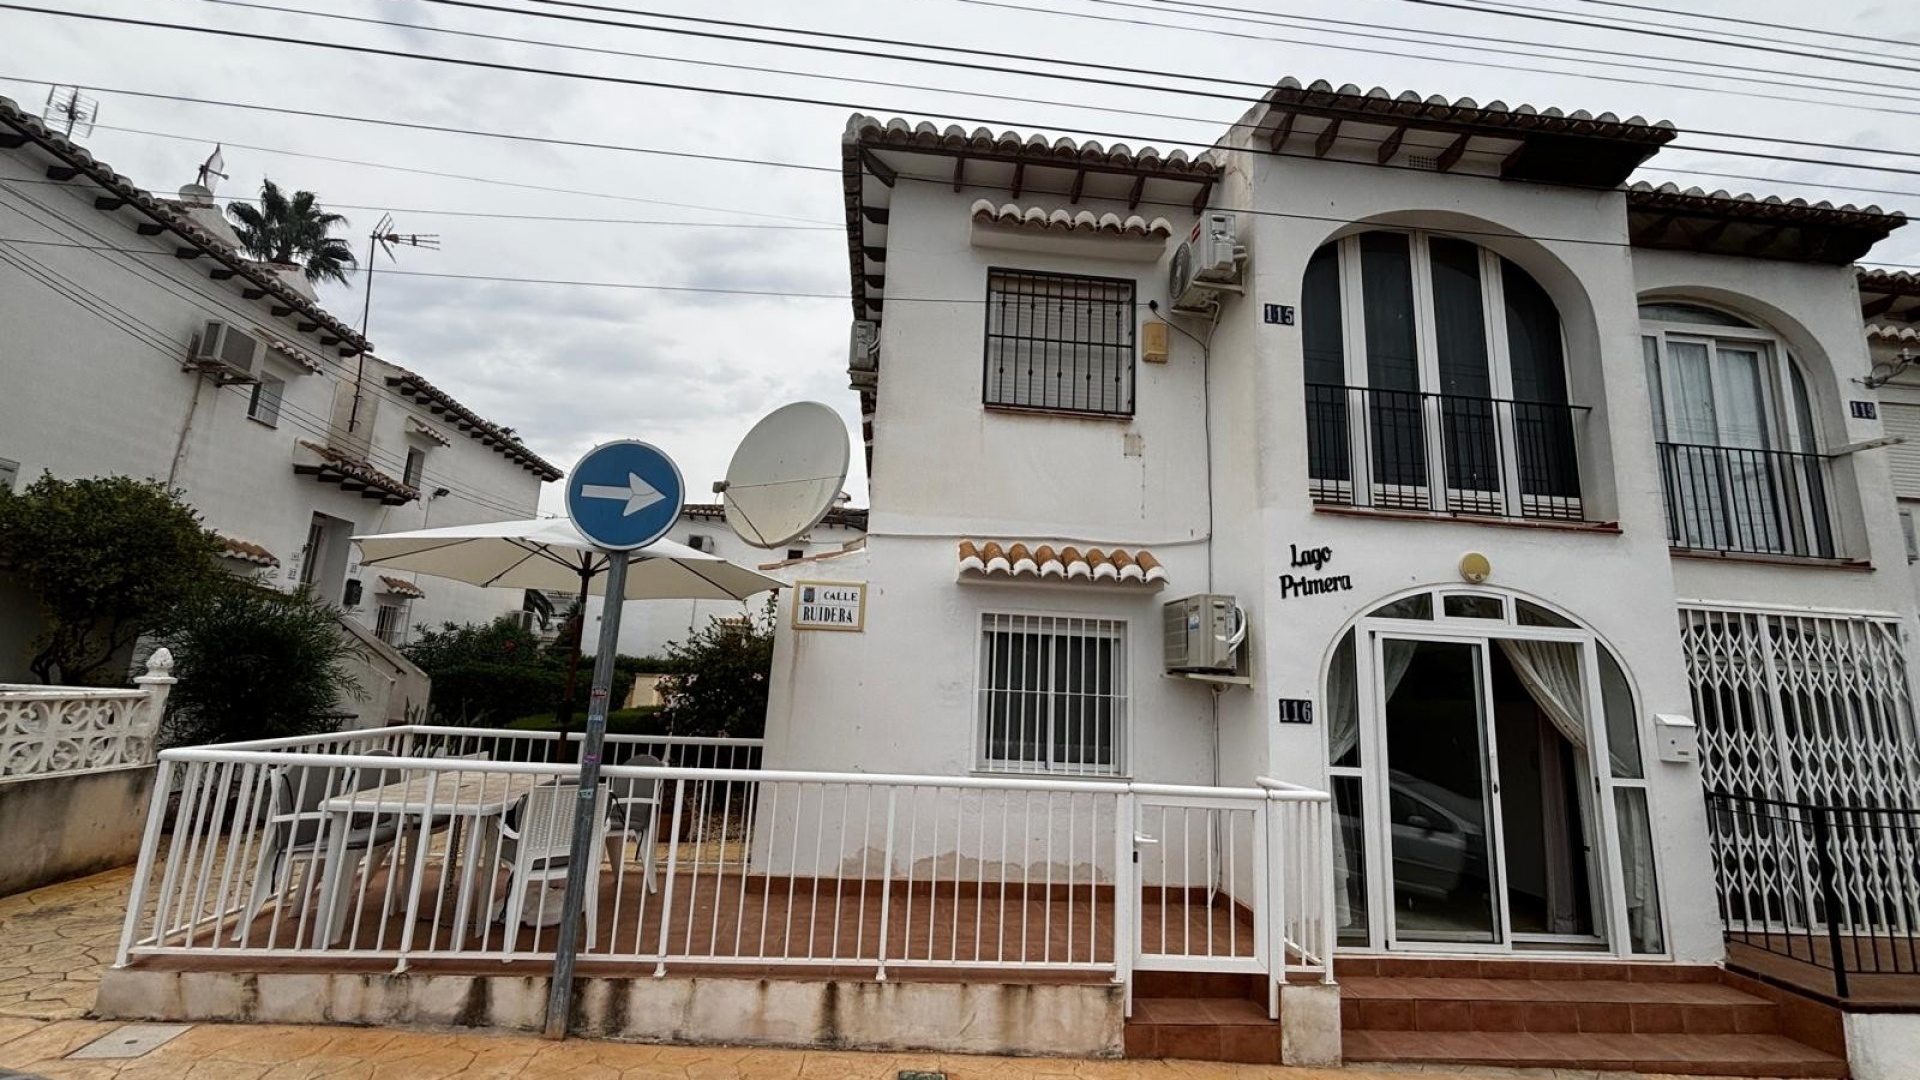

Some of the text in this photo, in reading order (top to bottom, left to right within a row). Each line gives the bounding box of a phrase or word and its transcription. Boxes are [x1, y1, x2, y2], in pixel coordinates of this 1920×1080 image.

[1265, 305, 1294, 325] 115
[1852, 402, 1876, 418] 119
[1289, 544, 1333, 571] Lago
[823, 591, 859, 602] CALLE
[1279, 574, 1353, 599] Primera
[803, 606, 853, 623] RUIDERA
[1280, 700, 1312, 722] 116
